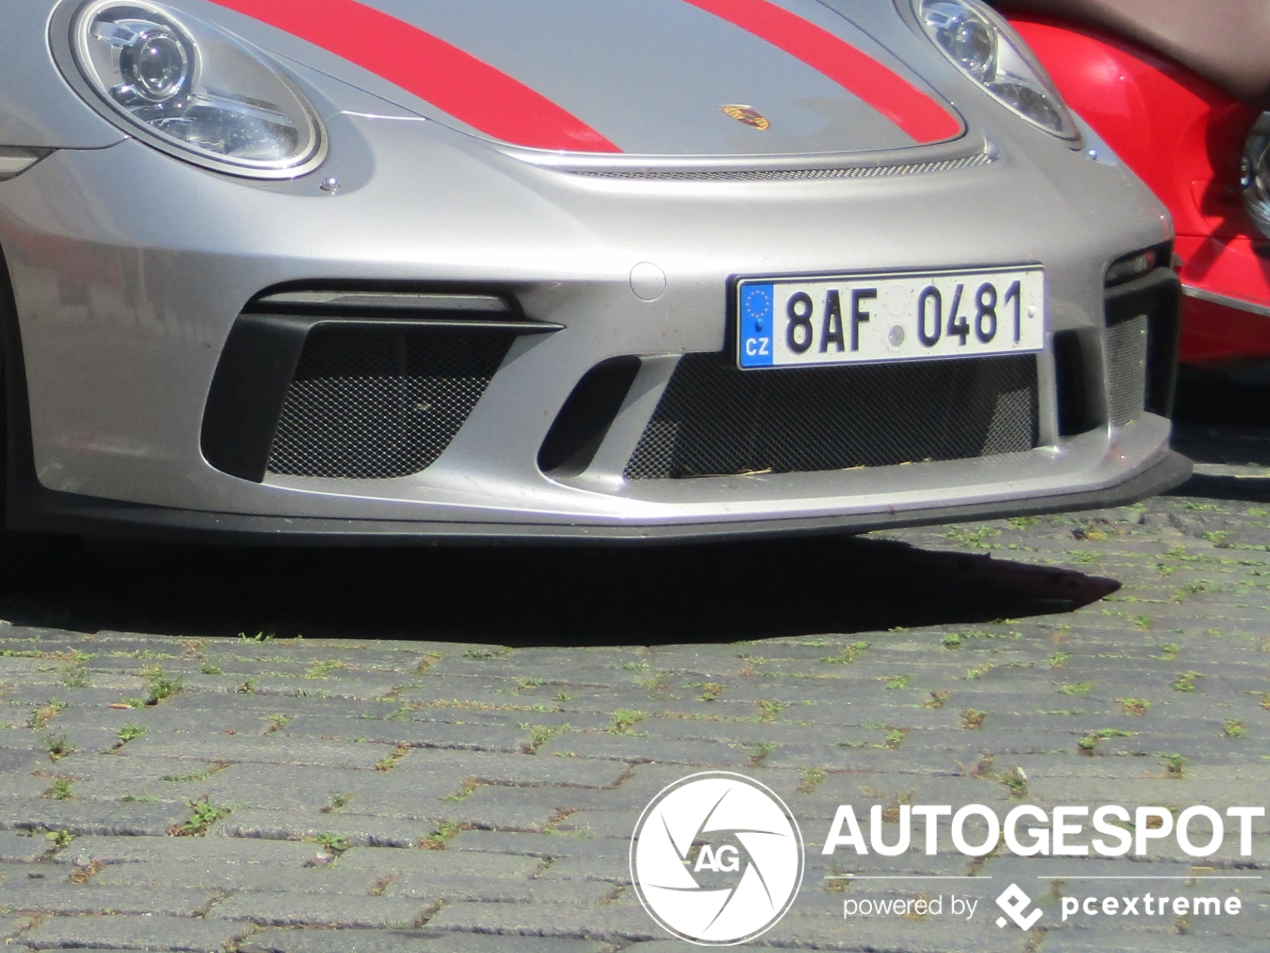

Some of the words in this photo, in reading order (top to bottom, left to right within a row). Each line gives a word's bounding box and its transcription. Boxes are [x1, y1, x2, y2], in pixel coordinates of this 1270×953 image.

[785, 287, 877, 353] 8AF
[917, 280, 1021, 347] 0481
[745, 337, 769, 356] CZ
